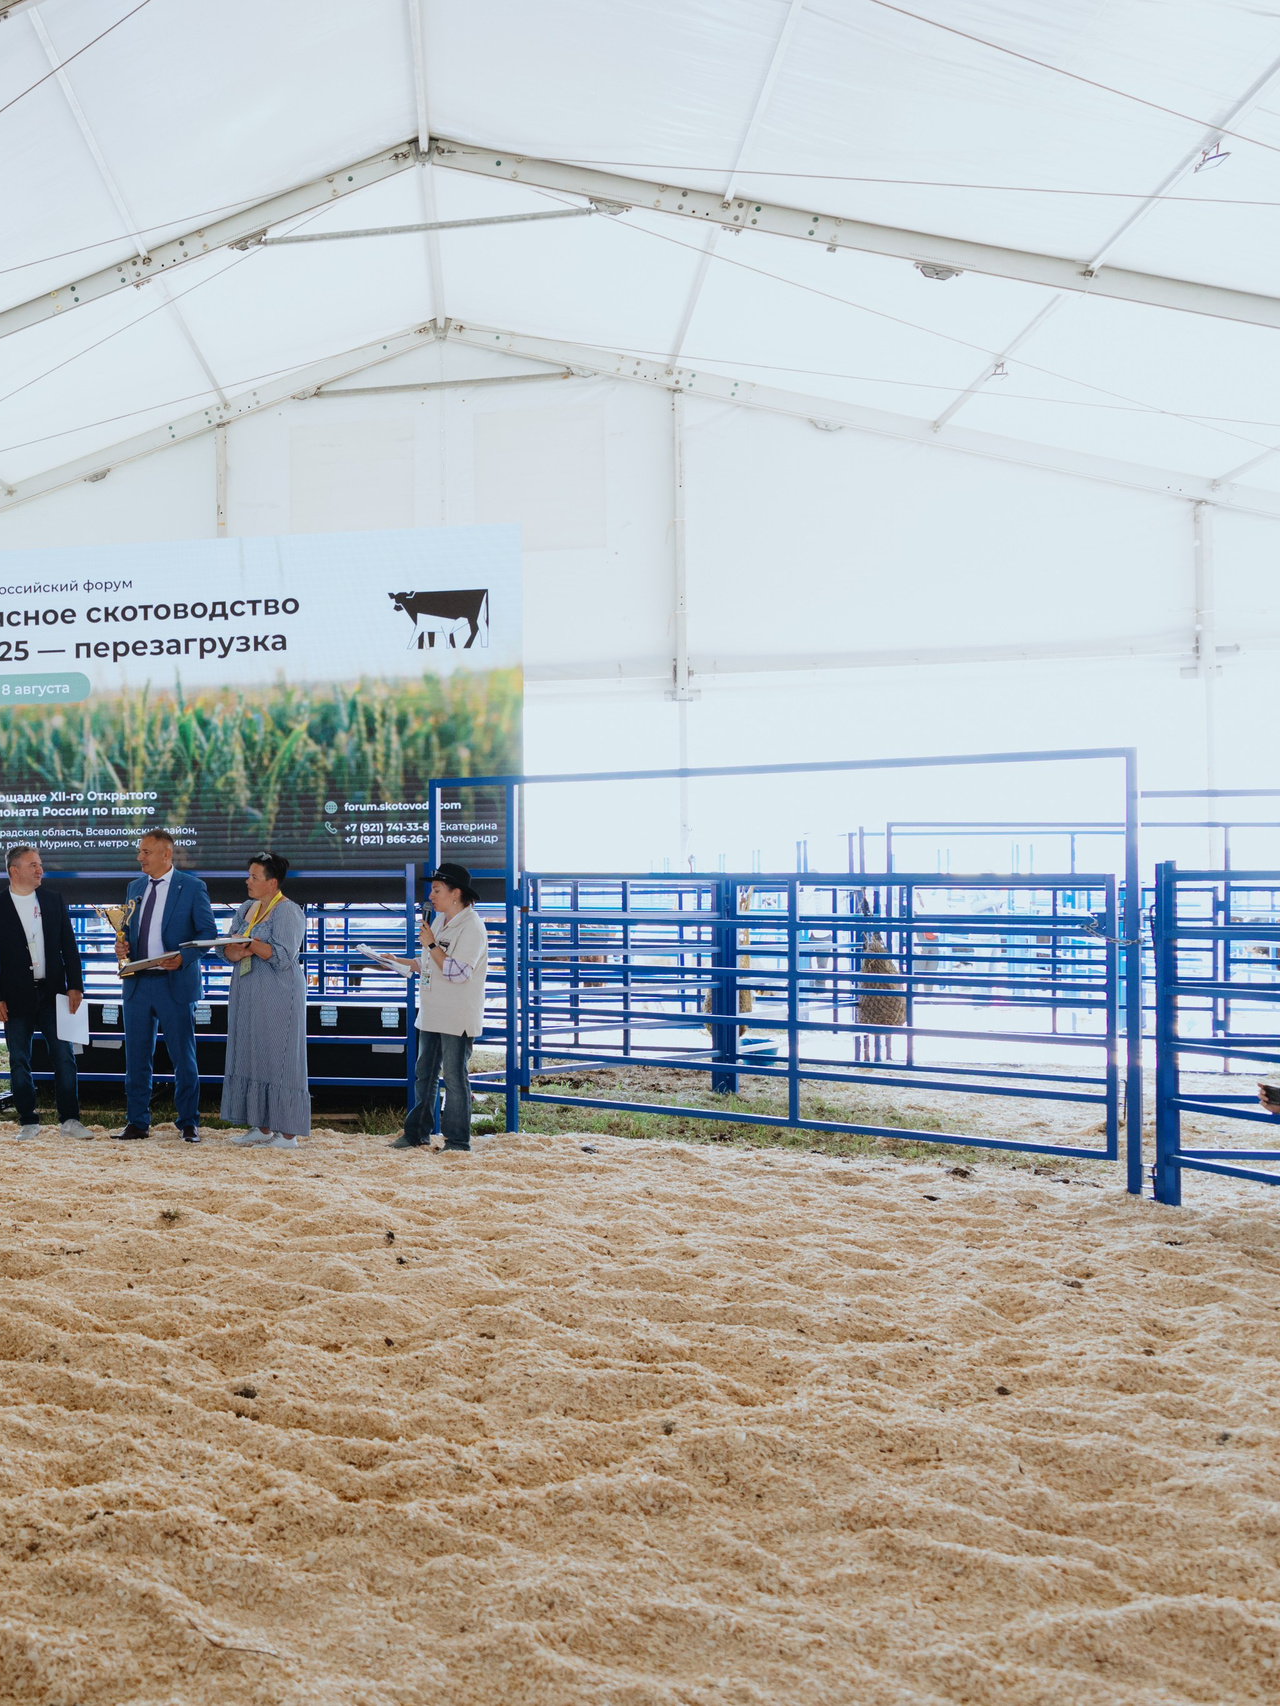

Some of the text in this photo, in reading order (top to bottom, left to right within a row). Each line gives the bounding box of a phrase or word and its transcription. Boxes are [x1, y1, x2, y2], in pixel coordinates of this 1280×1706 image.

[83, 579, 132, 593] форум
[86, 598, 299, 623] скотоводство
[75, 634, 287, 662] перезагрузка
[2, 684, 10, 695] 8
[14, 684, 70, 697] августа
[50, 792, 84, 802] XII-го
[87, 791, 158, 802] Открытого
[43, 806, 88, 817] России
[92, 807, 108, 816] по
[112, 806, 155, 816] пахоте
[42, 828, 83, 837] область,
[163, 825, 197, 836] район,
[344, 822, 497, 833] +7 (921) 741-33-8 Екатерина
[6, 840, 37, 849] район
[40, 840, 81, 850] Мурино,
[98, 840, 129, 849] метро
[344, 835, 357, 844] +7
[360, 834, 383, 846] (921)
[439, 835, 498, 844] Александр
